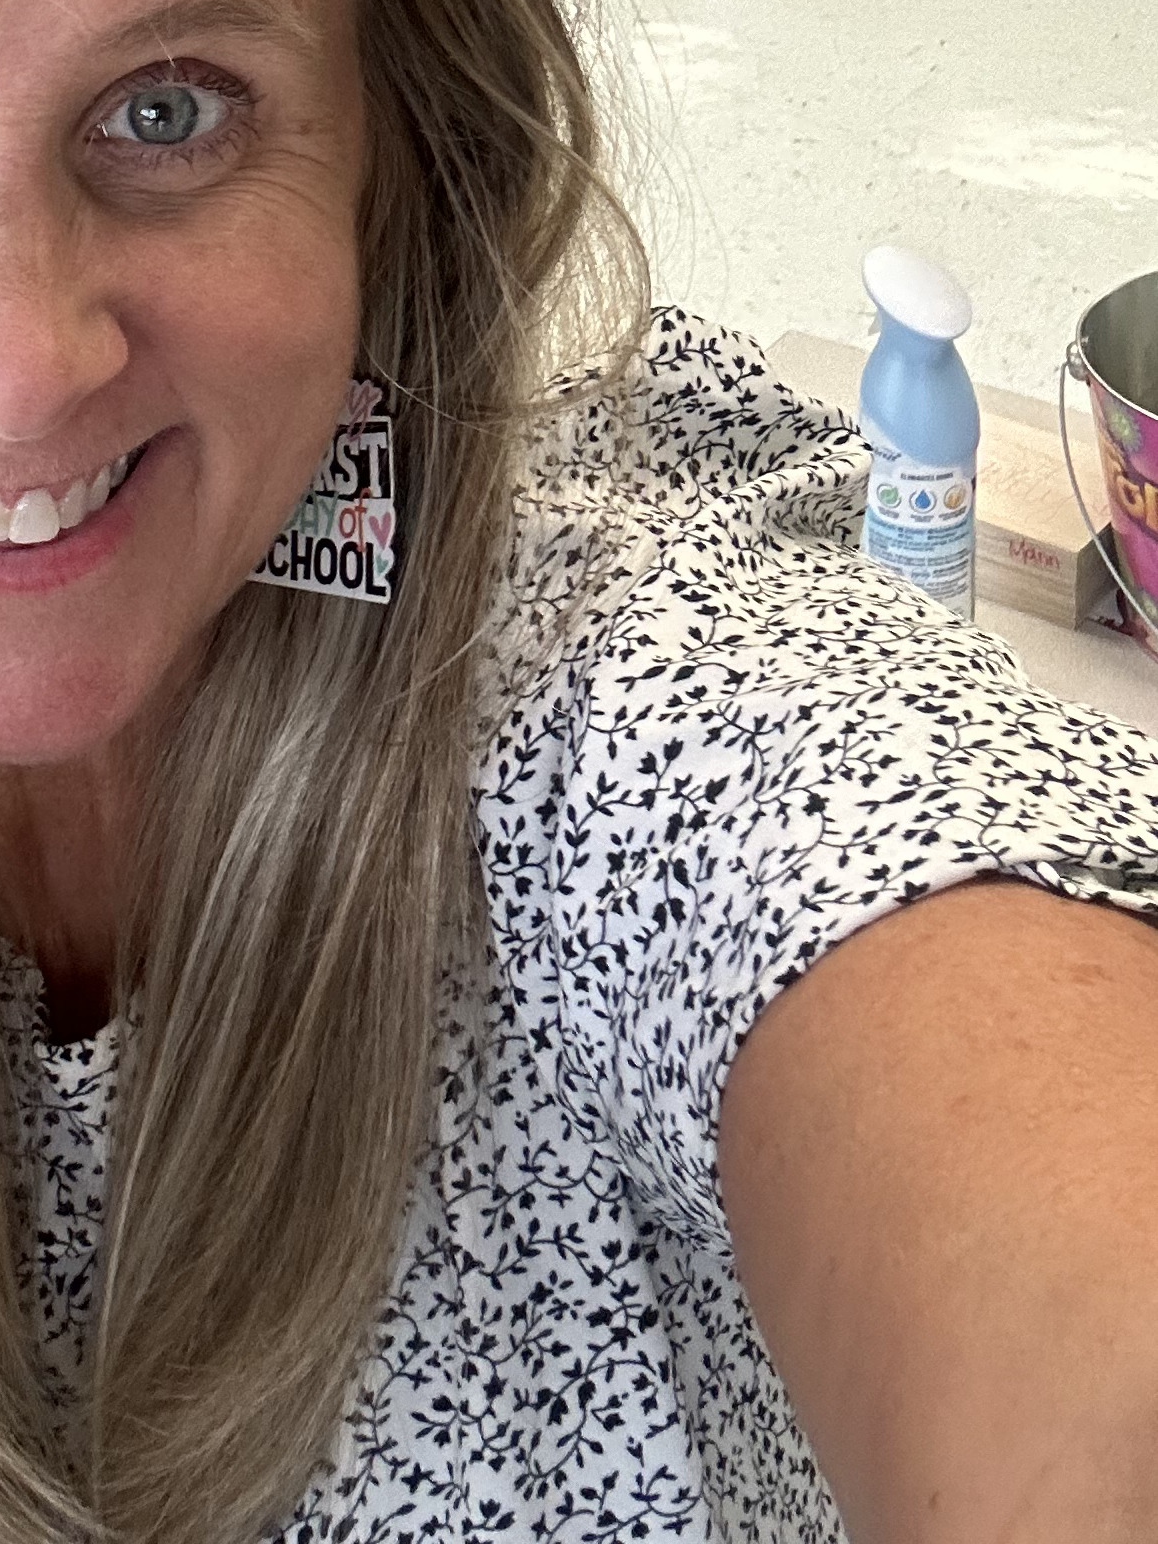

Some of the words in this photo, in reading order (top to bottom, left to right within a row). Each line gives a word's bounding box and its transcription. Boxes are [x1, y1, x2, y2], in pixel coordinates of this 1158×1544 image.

[285, 490, 340, 537] AY
[338, 487, 372, 552] of
[255, 529, 387, 597] CHOOL
